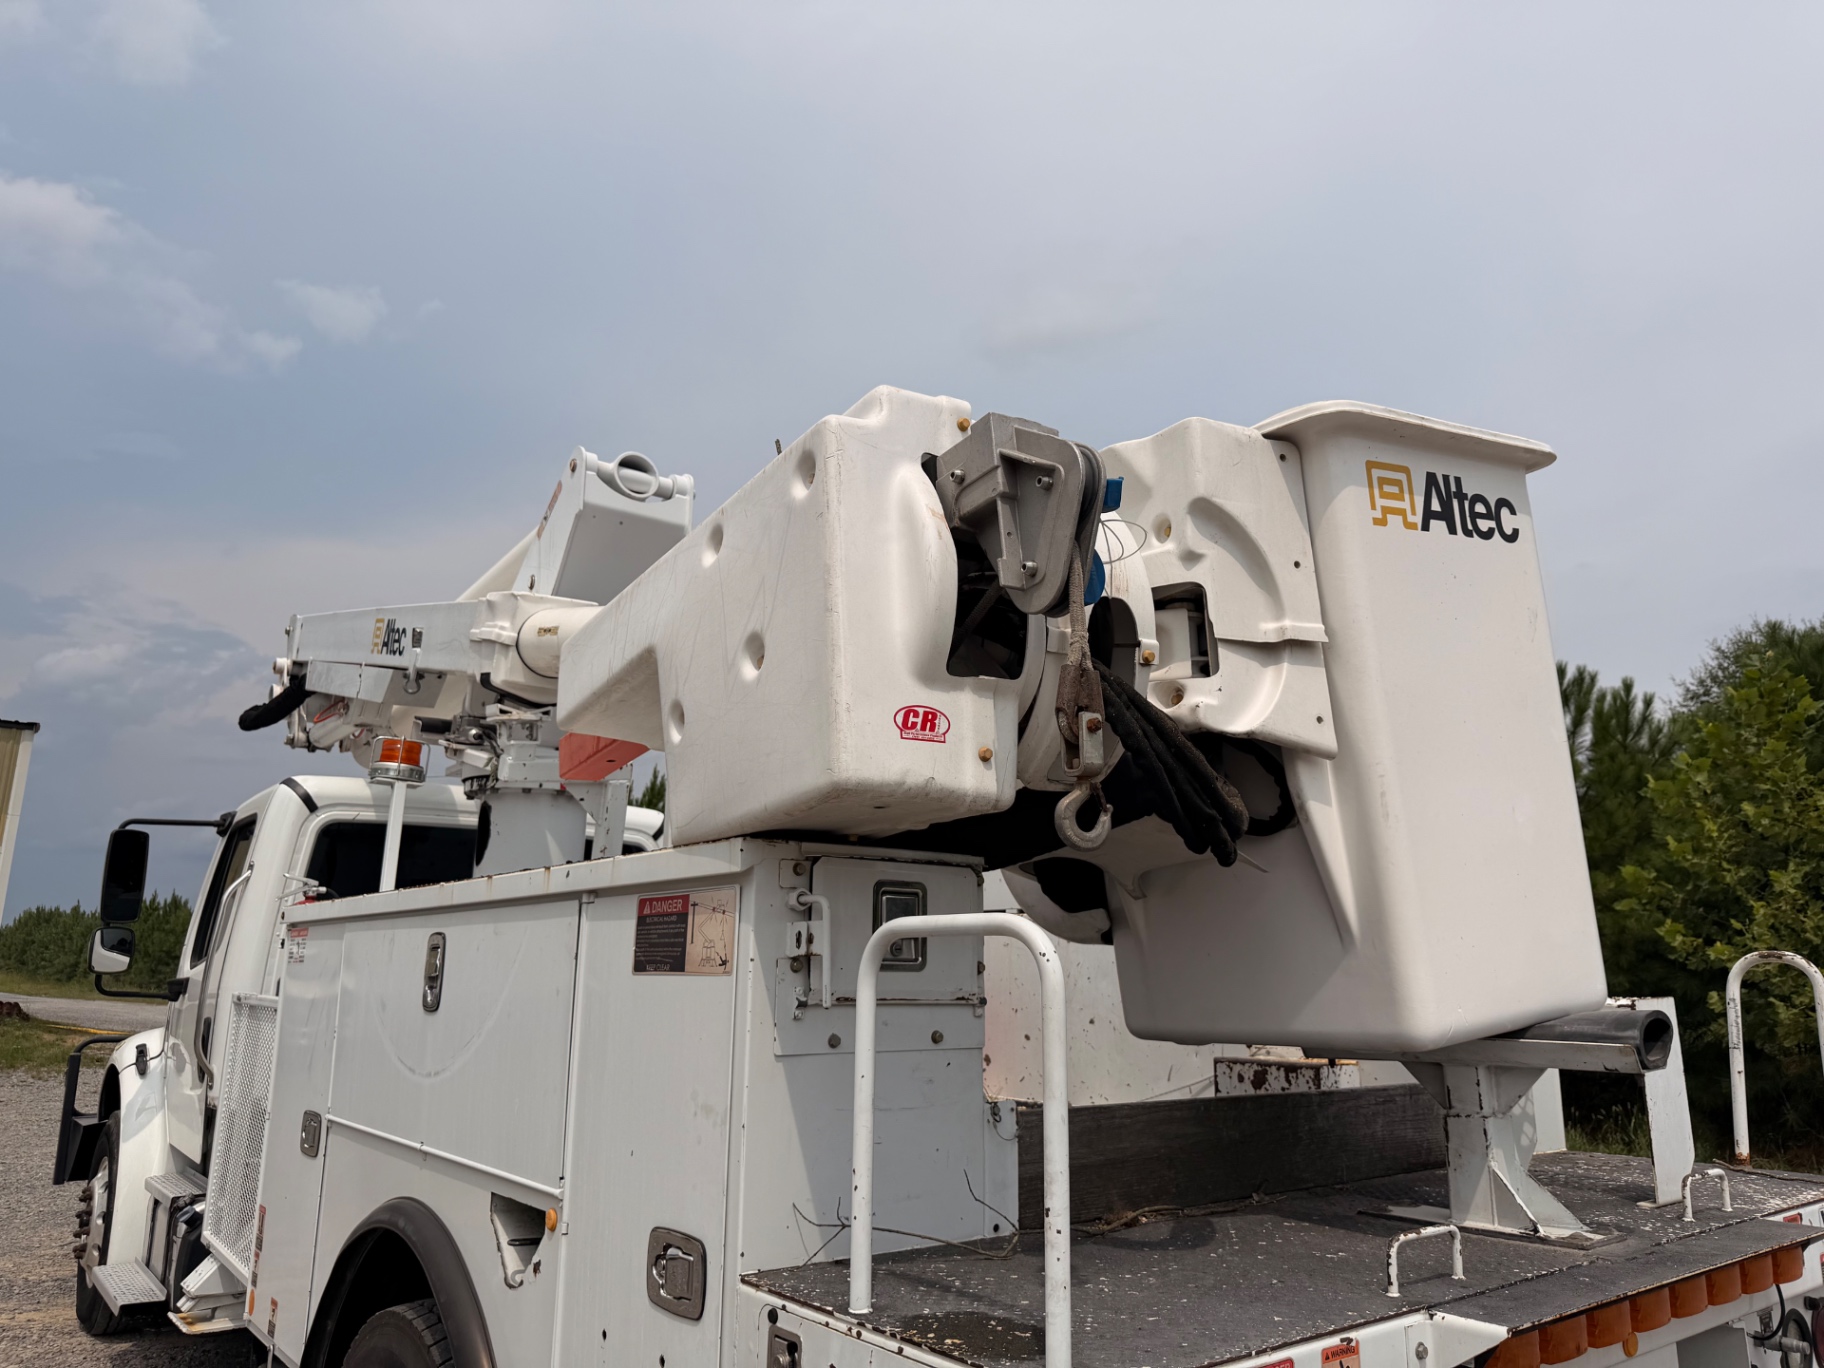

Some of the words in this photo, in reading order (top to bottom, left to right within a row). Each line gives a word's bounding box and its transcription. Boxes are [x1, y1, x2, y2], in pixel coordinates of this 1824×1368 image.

[1421, 471, 1520, 544] Altec
[381, 618, 407, 657] Altec
[901, 708, 938, 733] CR
[652, 899, 683, 913] DANGER
[1330, 1345, 1356, 1360] WARNING
